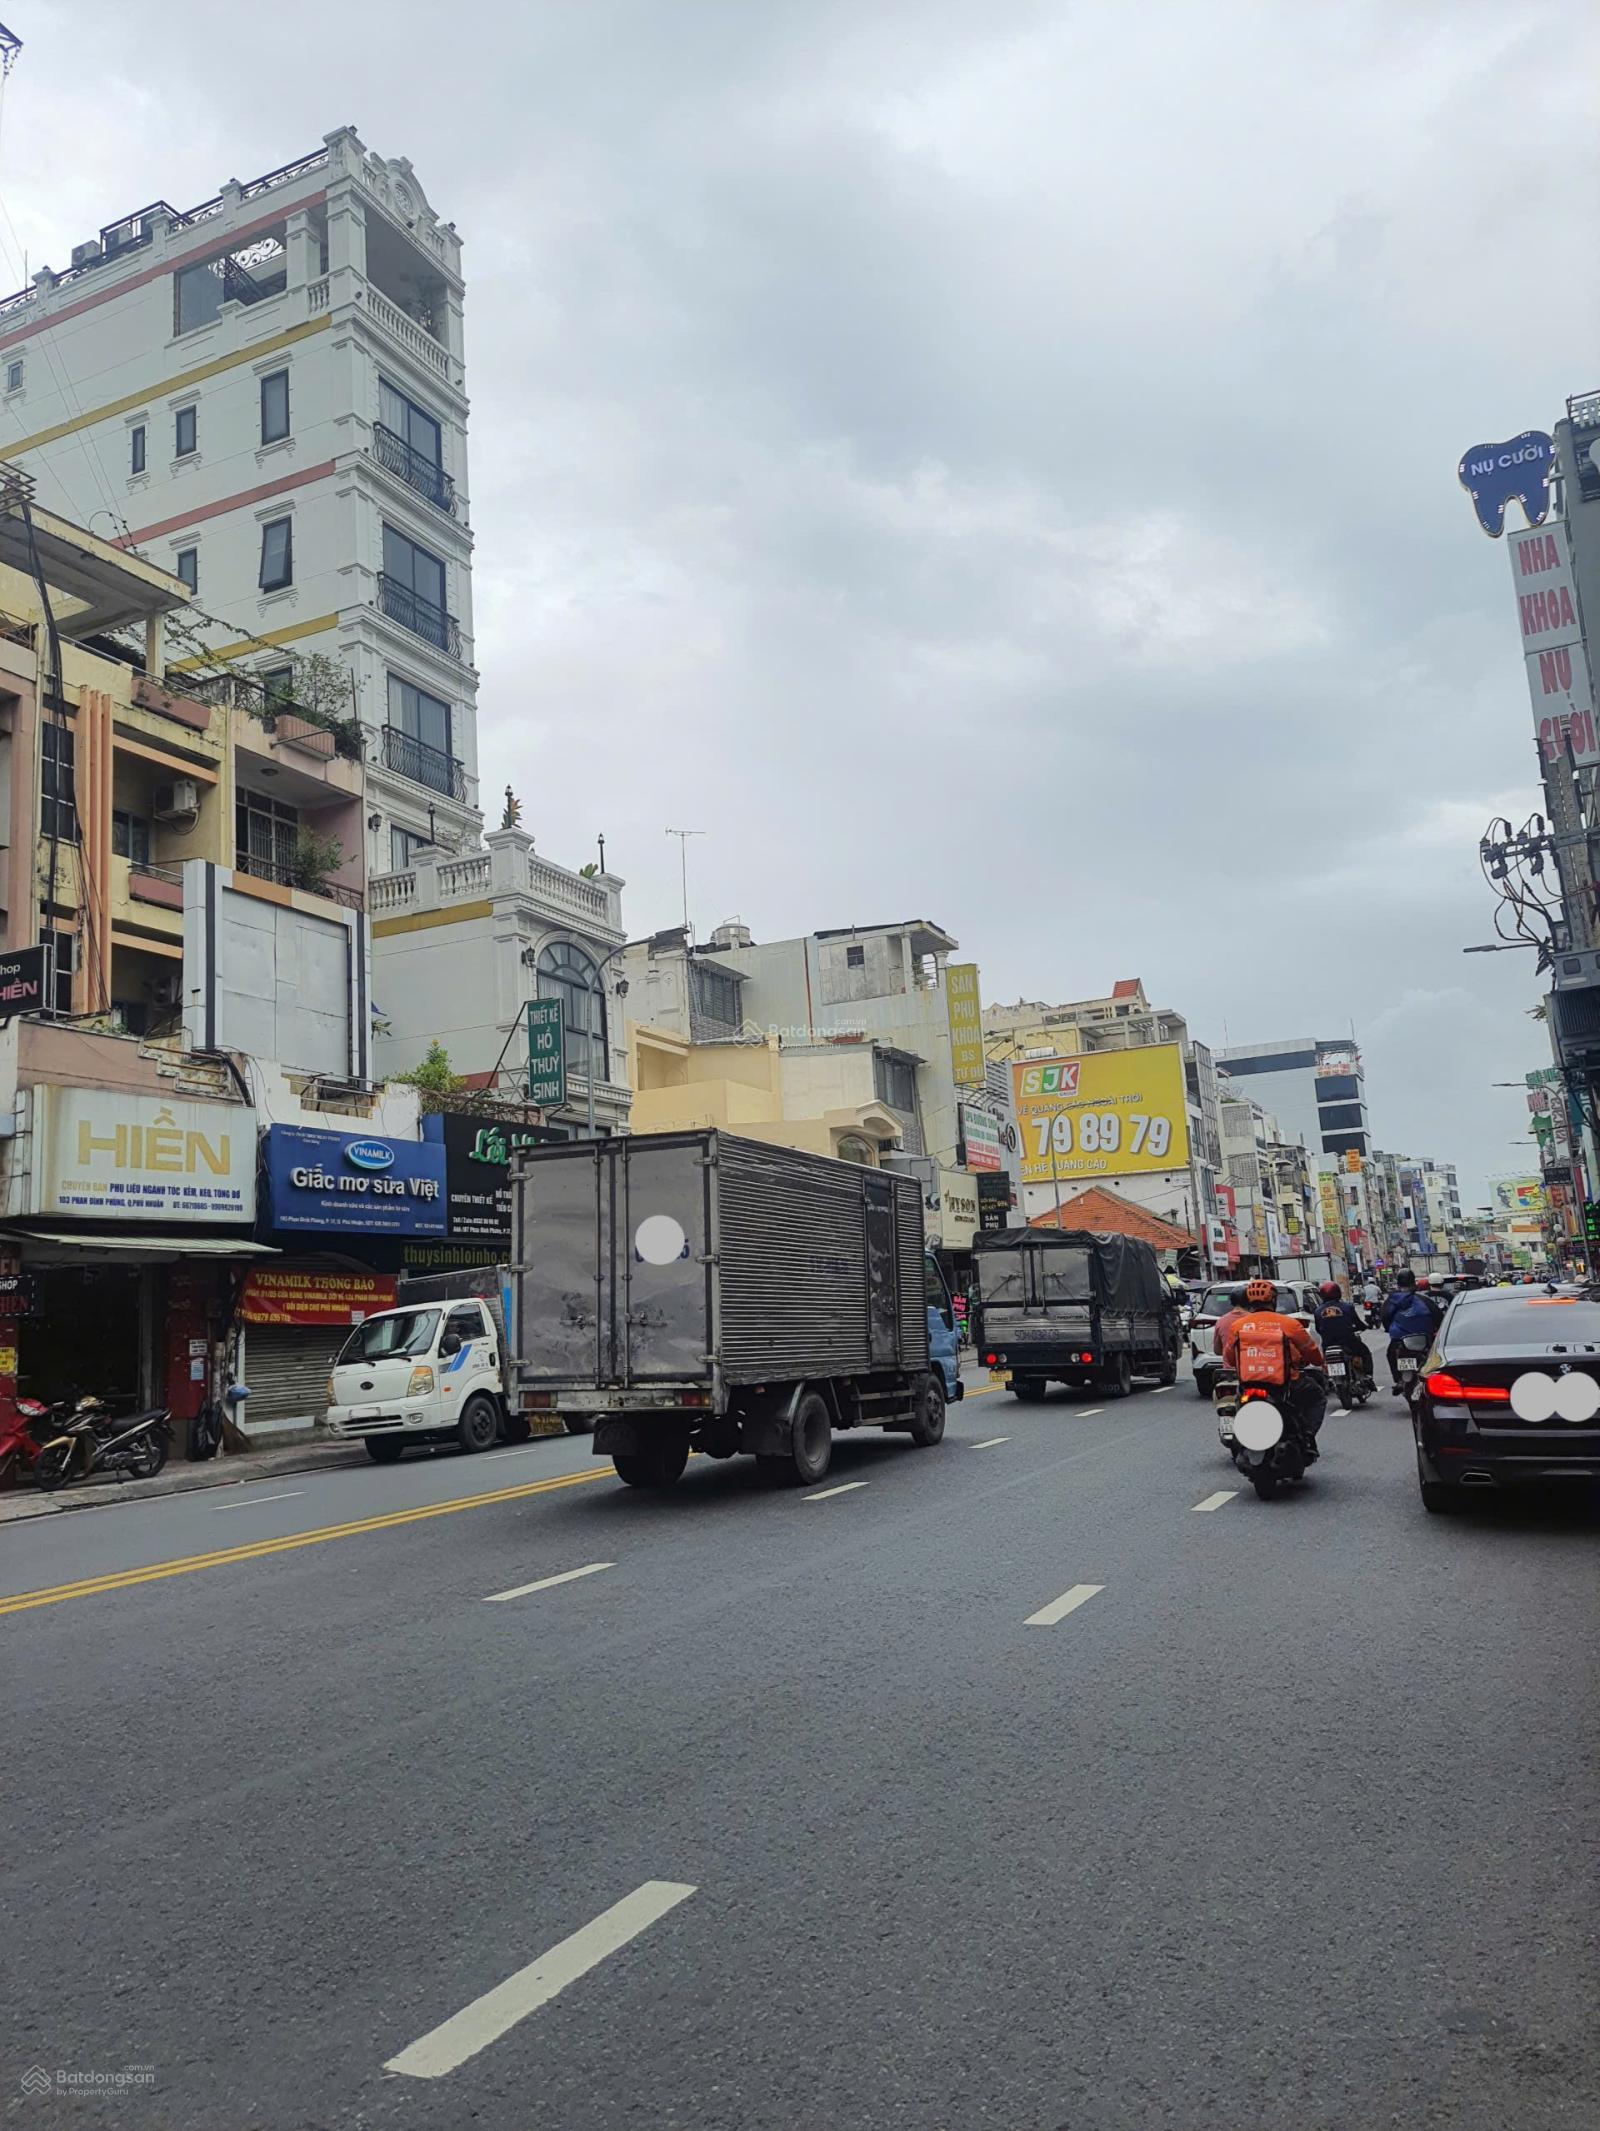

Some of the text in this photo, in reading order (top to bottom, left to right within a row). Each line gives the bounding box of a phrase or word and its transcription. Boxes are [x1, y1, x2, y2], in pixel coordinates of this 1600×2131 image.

[1470, 443, 1544, 476] NỤ CƯỜI
[1518, 534, 1561, 576] NHA
[1519, 586, 1577, 636] KHOA
[1538, 648, 1572, 699] NỤ
[0, 965, 20, 975] hop
[530, 1003, 559, 1026] THIẾT KẾ
[952, 1026, 980, 1046] KHOA
[533, 1081, 559, 1099] SINH
[1025, 1065, 1077, 1094] SJK
[79, 1106, 231, 1176] HIỀN
[1031, 1115, 1073, 1156] 79
[1079, 1112, 1121, 1152] 89
[1129, 1114, 1171, 1157] 79
[353, 1146, 391, 1161] VINAMILK
[110, 1182, 124, 1194] PHỤ
[126, 1183, 141, 1195] LIỆU
[290, 1163, 440, 1202] Giấc mơ sữa Việt
[72, 1196, 88, 1206] PHAN
[255, 1273, 375, 1290] VINAMILK THÔNG BÁO
